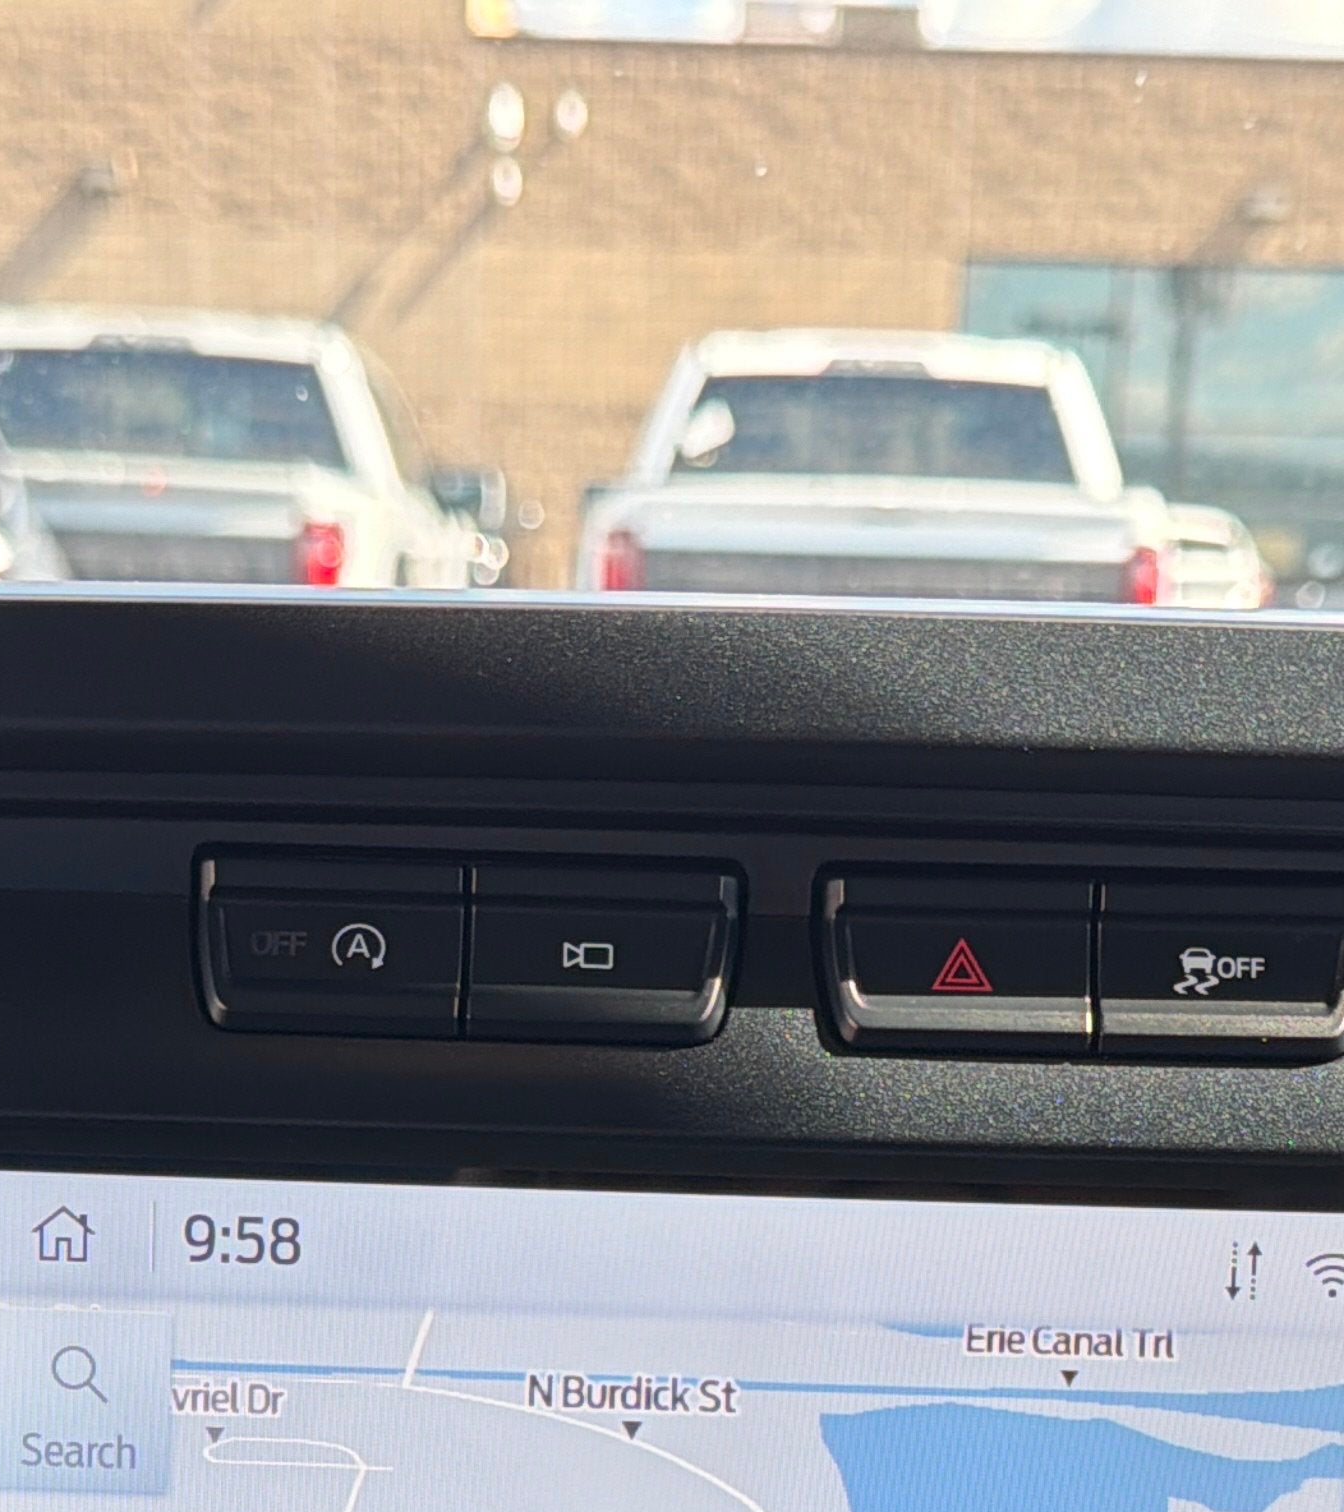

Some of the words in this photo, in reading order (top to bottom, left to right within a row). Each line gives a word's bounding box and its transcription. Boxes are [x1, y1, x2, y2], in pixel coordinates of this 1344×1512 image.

[251, 930, 308, 957] OFF
[1217, 956, 1266, 979] OFF
[183, 1214, 303, 1265] 9:58
[966, 1323, 1026, 1353] Erie
[1032, 1326, 1124, 1357] Canal
[1132, 1328, 1175, 1358] Trl
[172, 1381, 239, 1413] vriel
[248, 1383, 285, 1415] Dr
[528, 1374, 553, 1407] N
[562, 1375, 690, 1412] Burdick
[700, 1380, 737, 1413] St
[21, 1432, 136, 1469] Search
